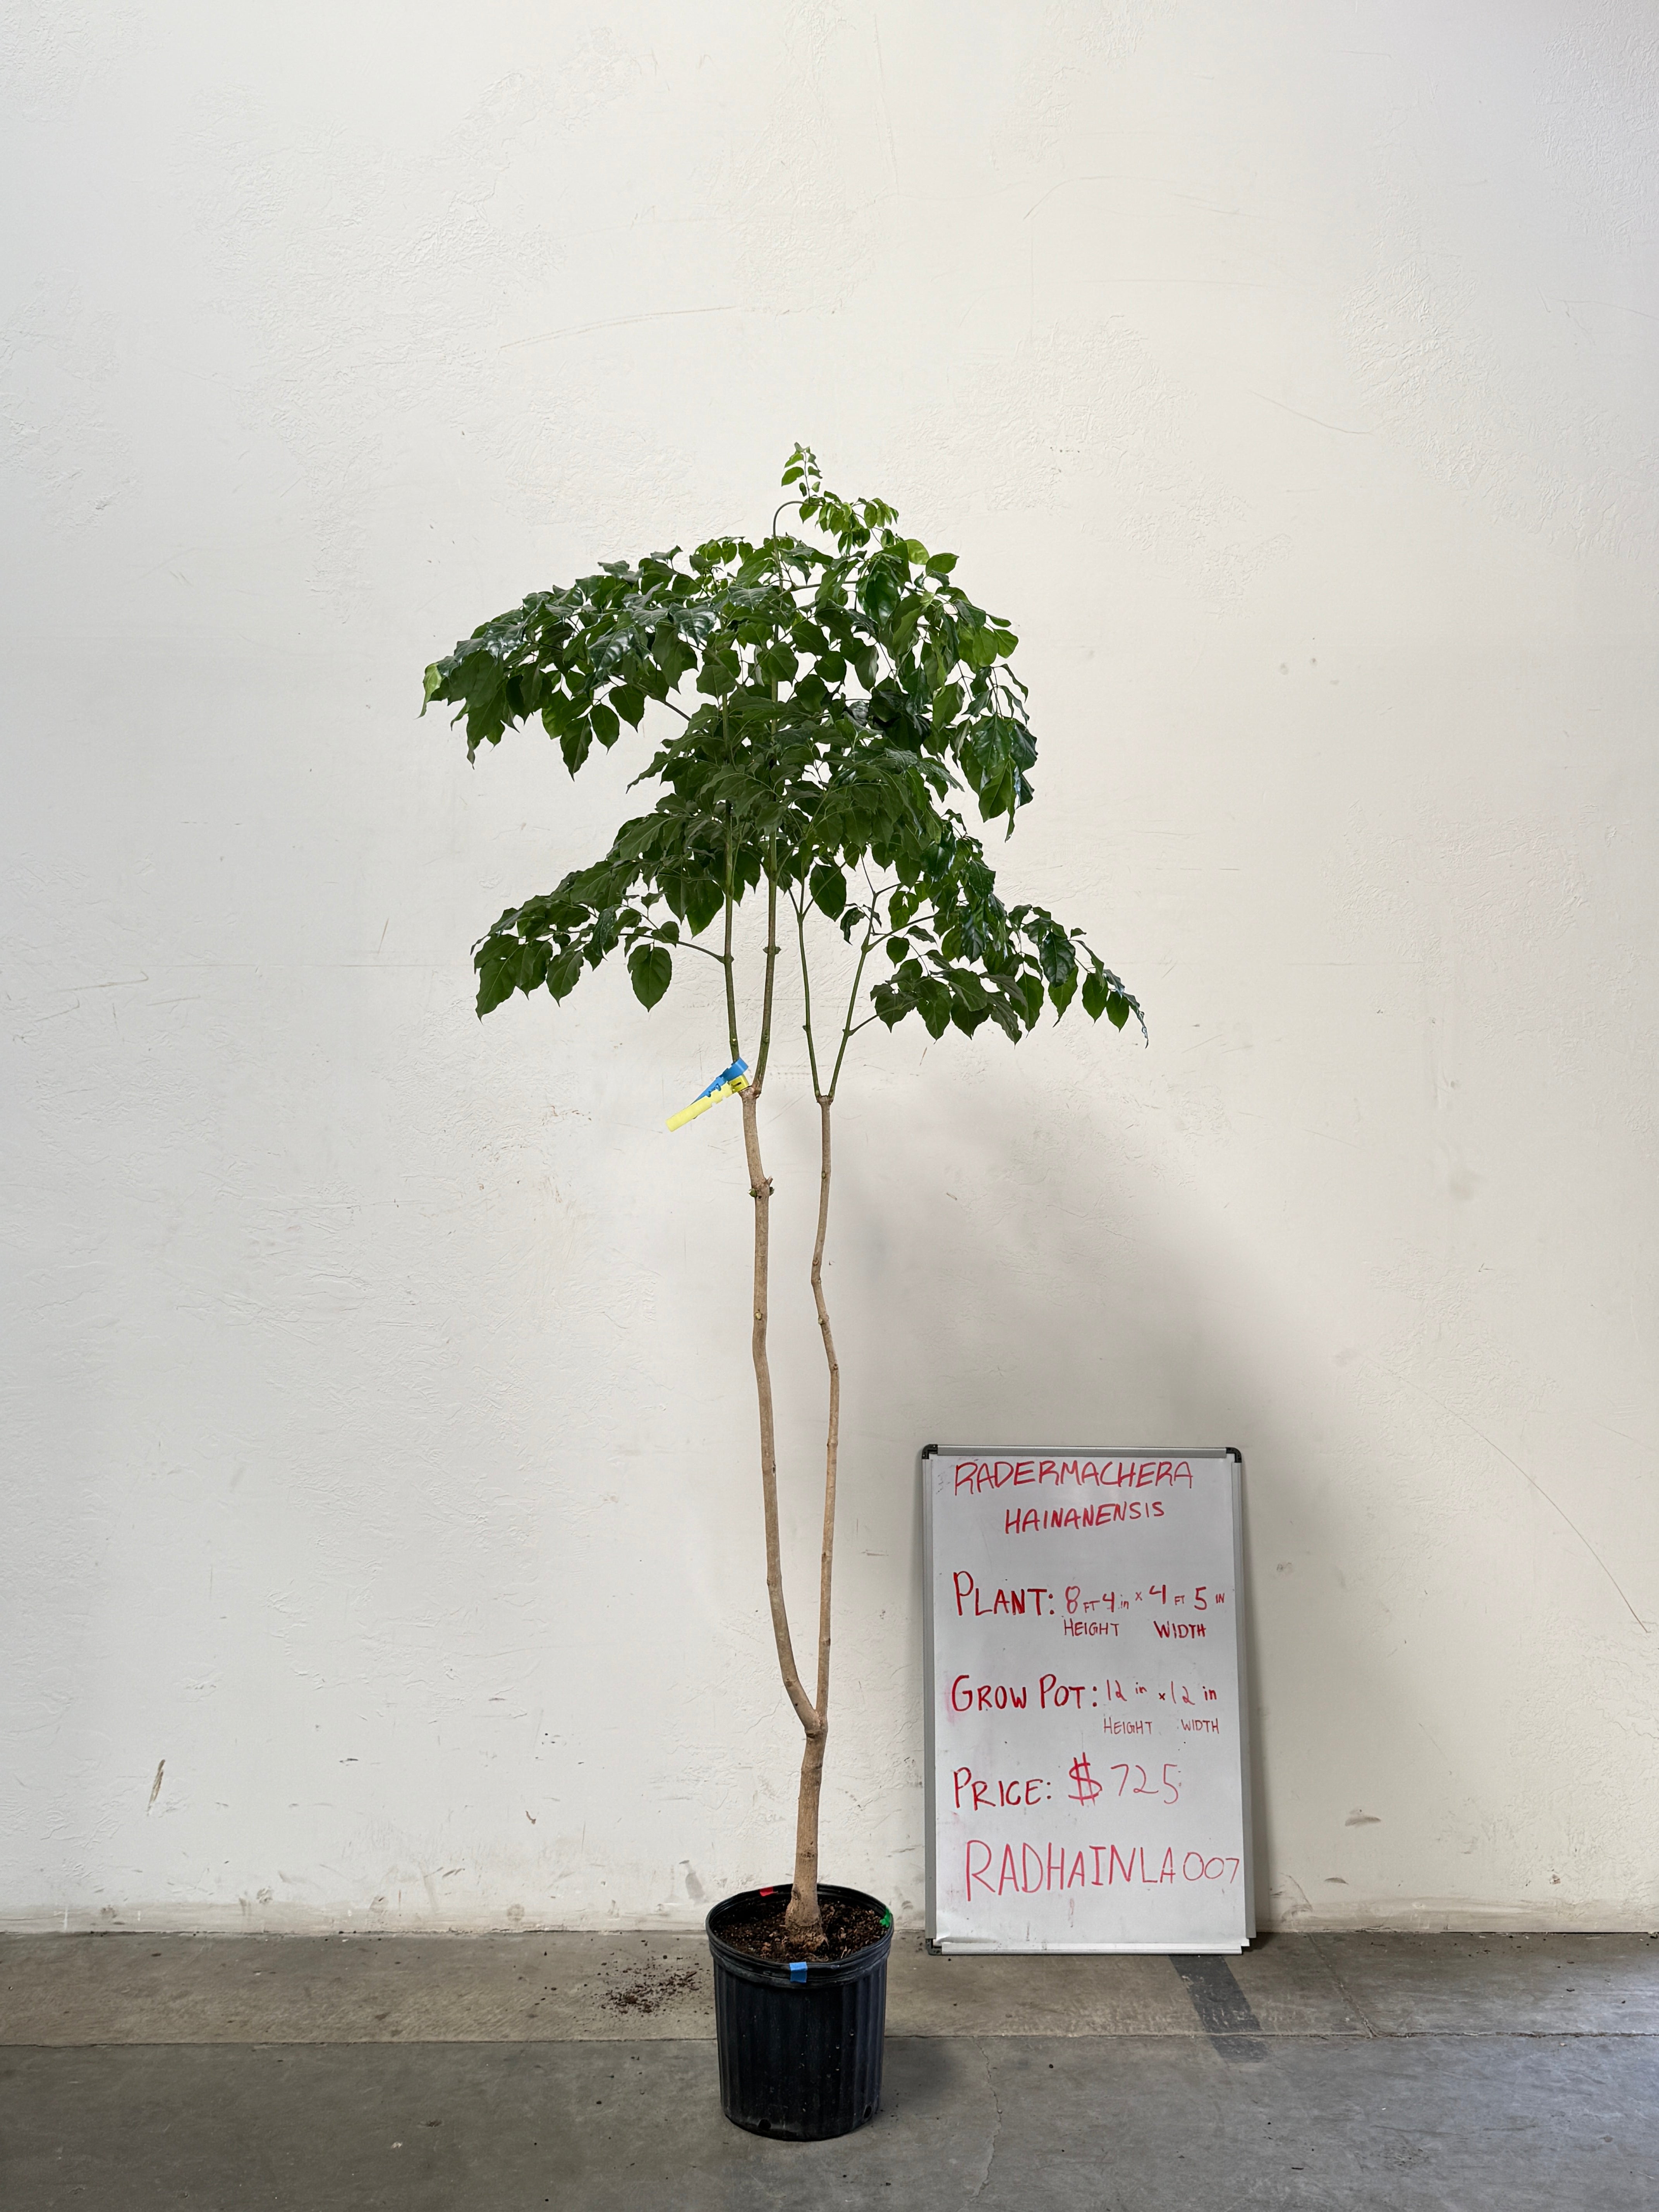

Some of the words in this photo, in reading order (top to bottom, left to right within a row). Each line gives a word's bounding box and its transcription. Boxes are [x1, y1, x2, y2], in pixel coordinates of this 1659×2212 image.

[954, 1460, 1192, 1495] RADERMACHERA
[1005, 1501, 1164, 1534] HAINANENSIS
[953, 1571, 1055, 1616] PLANT:
[1064, 1585, 1081, 1614] 8
[1102, 1592, 1115, 1613] 4
[1148, 1584, 1167, 1605] 4
[1194, 1586, 1207, 1611] 5
[1064, 1619, 1118, 1637] HEIGHT
[1153, 1621, 1206, 1639] WIDTH
[950, 1674, 1027, 1712] GROW
[1039, 1673, 1097, 1709] POT:
[1104, 1717, 1152, 1735] HEIGHT
[1181, 1719, 1219, 1734] WIDTH
[953, 1767, 1051, 1811] PRICE:
